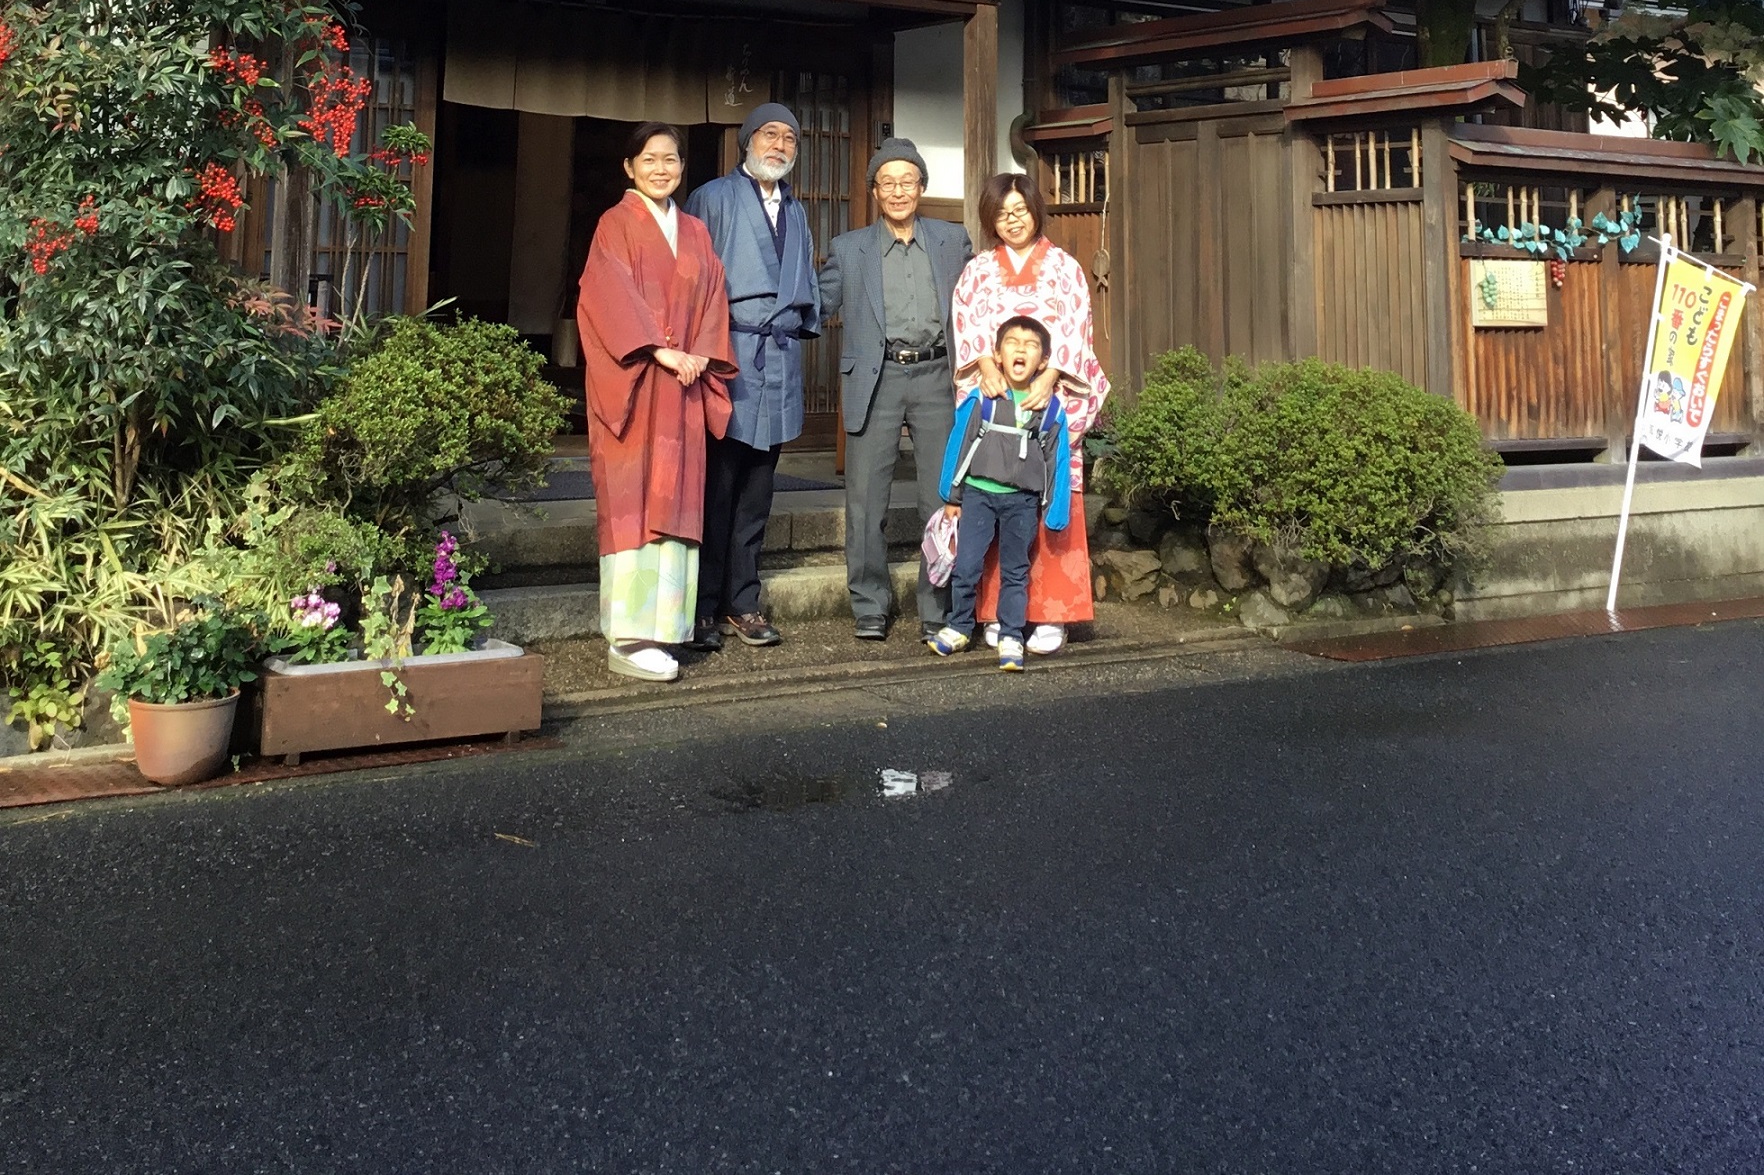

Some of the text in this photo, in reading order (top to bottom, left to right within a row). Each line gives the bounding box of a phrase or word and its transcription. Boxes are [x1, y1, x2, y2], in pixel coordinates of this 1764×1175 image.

[1686, 285, 1713, 347] こども
[1689, 295, 1729, 423] こまったらすぐおいで
